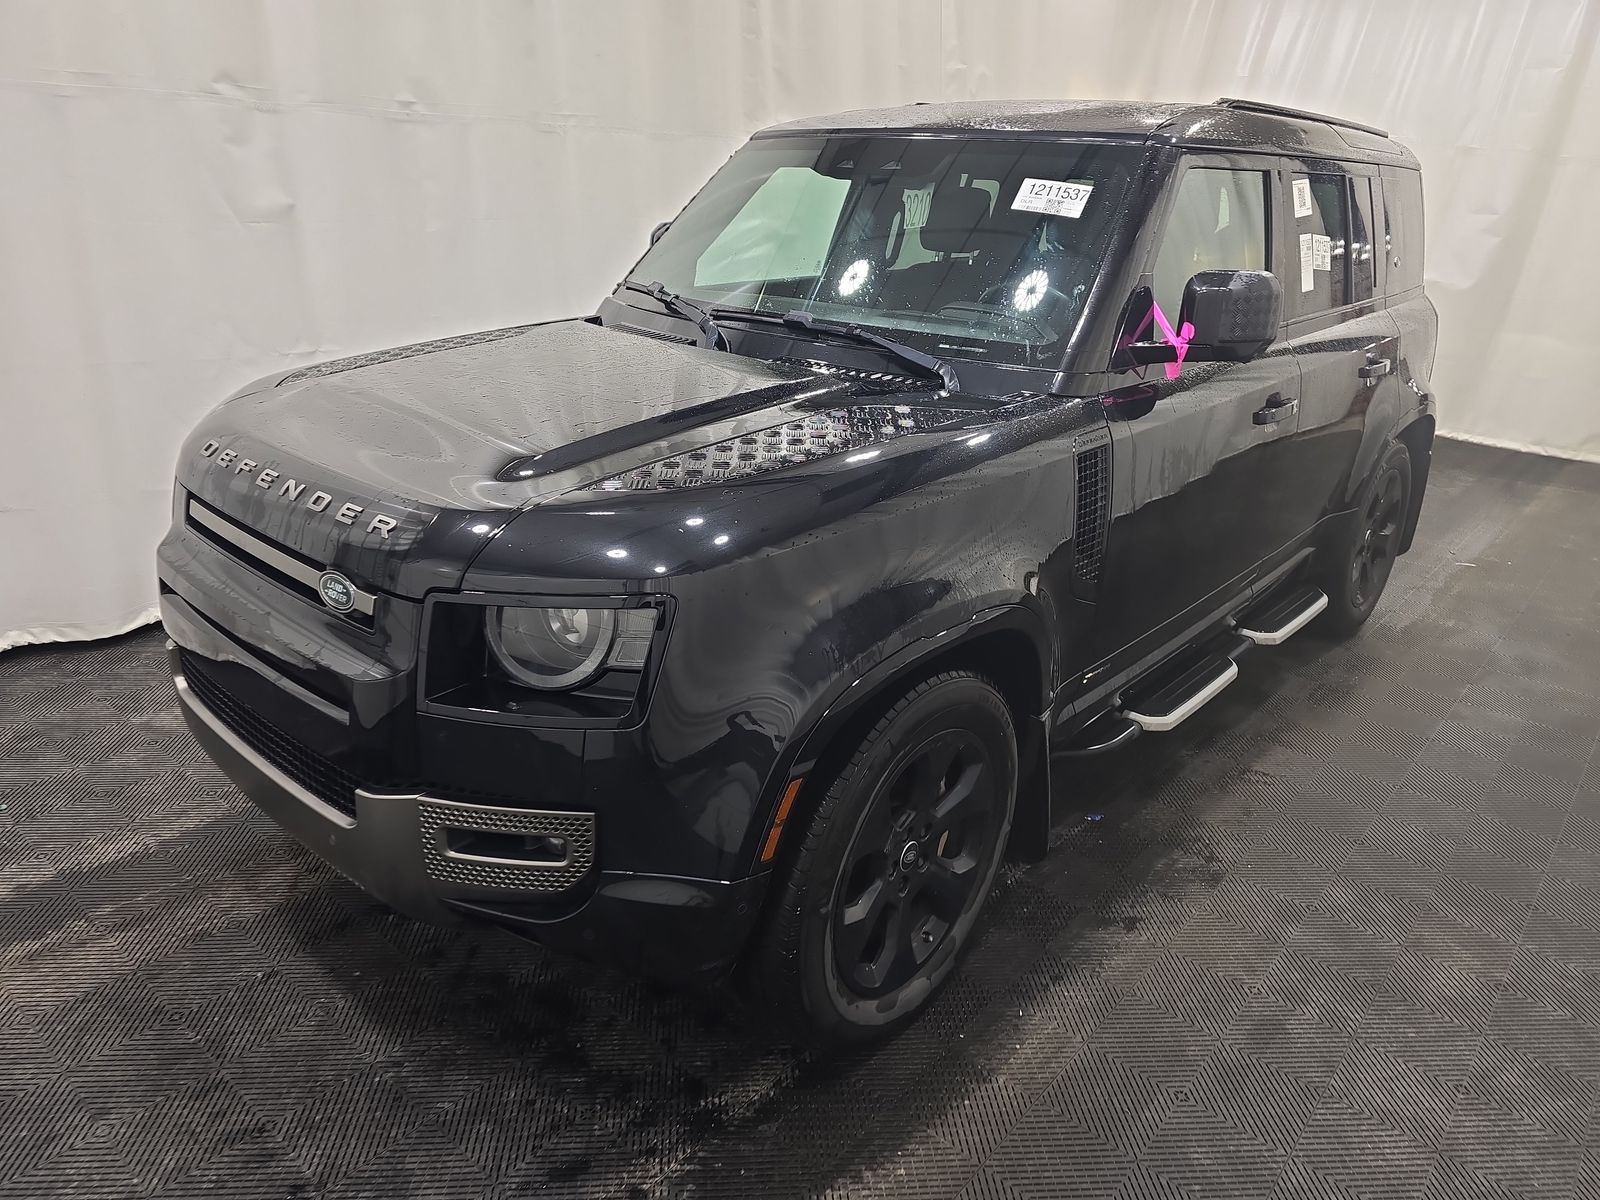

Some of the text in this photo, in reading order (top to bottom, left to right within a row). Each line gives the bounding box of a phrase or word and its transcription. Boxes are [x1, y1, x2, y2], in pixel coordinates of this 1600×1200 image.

[1029, 182, 1090, 202] 1211537
[200, 439, 398, 539] DEFENDER
[326, 579, 344, 593] LAND
[327, 588, 348, 604] ROVER
